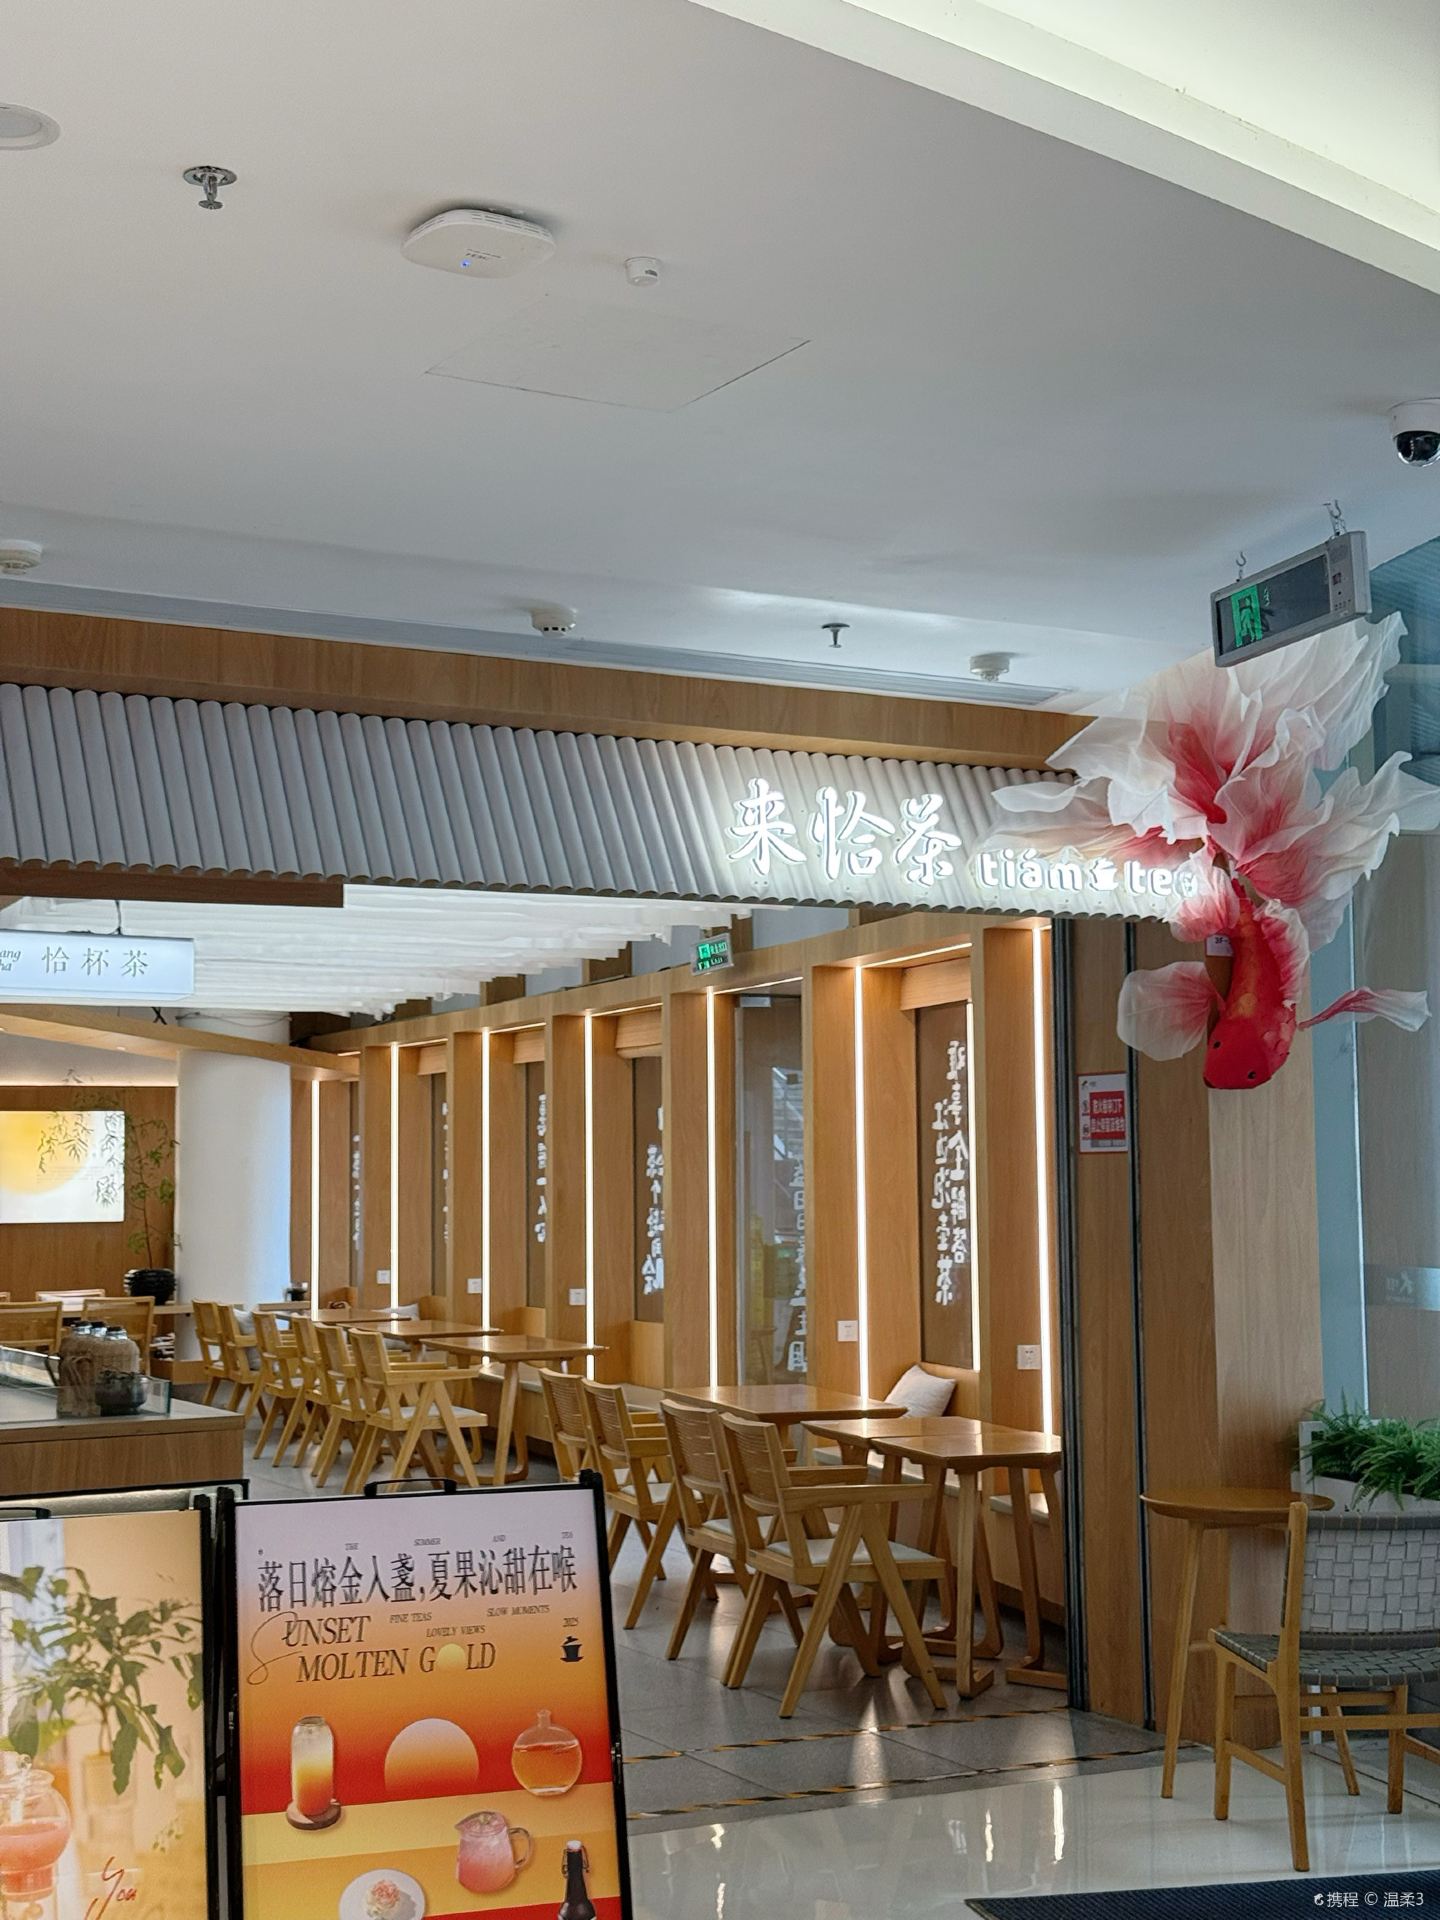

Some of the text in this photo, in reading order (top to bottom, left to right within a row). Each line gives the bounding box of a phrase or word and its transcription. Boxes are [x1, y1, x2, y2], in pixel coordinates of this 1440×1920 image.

[725, 778, 962, 887] 来恰茶
[41, 946, 149, 977] 恰杯茶
[411, 1611, 433, 1622] TEAS
[487, 1604, 551, 1617] SLOW MOMENTS
[426, 1624, 486, 1638] LOVELY VIEWS
[296, 1648, 409, 1683] MOLTEN
